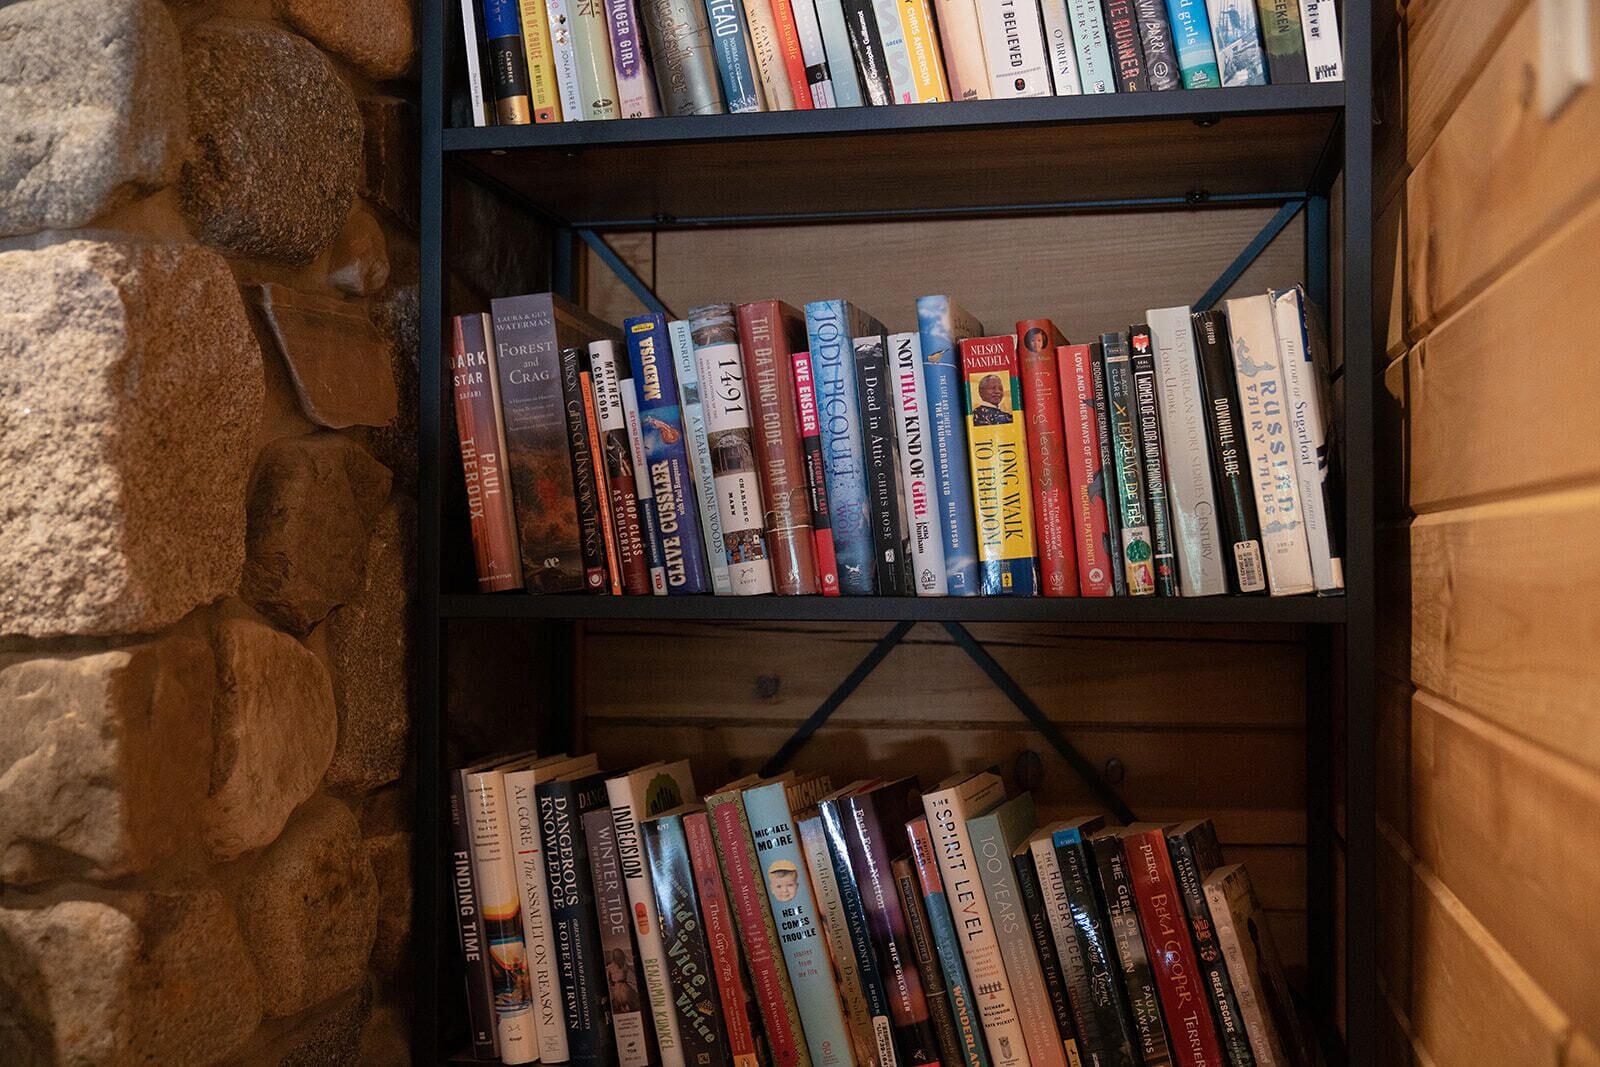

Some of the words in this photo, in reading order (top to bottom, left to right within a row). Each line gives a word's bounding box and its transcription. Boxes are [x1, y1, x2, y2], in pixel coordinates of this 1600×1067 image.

[526, 20, 538, 28] OF
[907, 7, 920, 35] CHRIS
[1090, 17, 1102, 48] TIME
[1145, 22, 1166, 54] BARRY
[1177, 11, 1199, 45] girls
[1307, 4, 1320, 38] River
[528, 32, 542, 60] CHOICE
[620, 41, 634, 69] GIRL
[729, 38, 738, 61] NORMA
[749, 9, 771, 84] WEIGHTMAN
[760, 26, 774, 62] GAVIN
[783, 24, 798, 60] Rushdie
[1003, 13, 1023, 67] BELIEVED
[1054, 29, 1069, 75] O'BRIEN
[913, 37, 930, 86] ANDERSON
[560, 50, 570, 78] JONAH
[566, 82, 577, 111] LEHRER
[496, 319, 551, 332] WATERMAN
[750, 317, 770, 343] THE
[814, 314, 842, 369] JODI
[1204, 321, 1216, 345] CLIFFORD
[498, 341, 554, 358] FOREST
[592, 353, 601, 364] B.
[677, 327, 691, 373] HEINRICH
[755, 347, 773, 366] DA
[897, 339, 913, 370] NOT
[965, 355, 1011, 369] MANDELA
[970, 343, 1004, 355] NELSON
[453, 371, 483, 387] STAR
[509, 369, 550, 385] CRAG
[604, 361, 620, 409] MATTHEW
[639, 336, 661, 400] MEDUSA
[715, 358, 744, 415] 1491
[795, 360, 810, 382] EVE
[1119, 368, 1129, 397] BLACK
[594, 366, 609, 420] CRAWFORD
[756, 368, 779, 407] VINCI
[865, 377, 881, 411] Dead
[900, 371, 918, 412] THAT
[1032, 371, 1052, 425] falling
[1138, 376, 1154, 405] WOMEN
[692, 416, 701, 425] A
[800, 386, 816, 431] ENSLER
[869, 416, 881, 430] in
[935, 402, 944, 418] THE
[1140, 405, 1155, 415] OF
[1214, 398, 1234, 447] DOWNHILL
[629, 411, 639, 436] BEYOND
[634, 436, 644, 467] MEASURE
[693, 427, 706, 456] YEAR
[762, 412, 783, 447] CODE
[823, 378, 855, 479] PICOULT
[905, 415, 922, 456] KIND
[1142, 416, 1157, 440] COLOR
[699, 457, 705, 465] in
[871, 434, 886, 467] Attic
[936, 420, 949, 479] THUNDERBOLT
[974, 438, 995, 460] TO
[997, 442, 1019, 486] LONG
[1039, 431, 1055, 487] leaves
[1146, 441, 1160, 459] AND
[1222, 449, 1240, 477] SLIDE
[1247, 383, 1265, 444] FAIRY
[1257, 454, 1276, 515] TALES
[460, 437, 483, 520] THEROUX
[480, 453, 501, 499] PAUL
[768, 458, 788, 486] DAN
[910, 458, 926, 479] OF
[1147, 459, 1163, 495] FEMINISM
[612, 489, 623, 502] AS
[624, 493, 637, 519] SHOP
[651, 459, 679, 534] CUSSLER
[702, 475, 717, 512] MAINE
[728, 492, 736, 516] MANN
[877, 472, 889, 507] CHRIS
[911, 481, 928, 519] GIRL
[943, 481, 951, 496] KID
[975, 467, 1002, 546] FREEDOM
[1080, 485, 1091, 522] MICHAEL
[772, 492, 795, 541] BROWN
[881, 511, 892, 540] ROSE
[948, 502, 957, 519] BILL
[1003, 492, 1024, 540] WALK
[615, 505, 631, 564] SOULCRAFT
[630, 524, 643, 557] CLASS
[709, 512, 724, 554] WOODS
[916, 522, 925, 554] Dunham
[951, 520, 960, 548] BRYSON
[1084, 523, 1095, 566] PATERNITI
[662, 535, 686, 587] CLIVE
[654, 572, 663, 590] TED
[515, 785, 528, 804] AL
[517, 807, 533, 846] GORE
[612, 805, 643, 880] INDECISION
[524, 859, 536, 880] The
[540, 796, 565, 910] KNOWLEDGE
[555, 796, 579, 906] DANGEROUS
[598, 826, 619, 892] WINTER
[981, 836, 1002, 873] 100
[1044, 852, 1055, 868] THE
[453, 852, 475, 916] FINDING
[936, 808, 967, 870] SPIRIT
[954, 879, 983, 941] LEVEL
[1067, 850, 1084, 894] PORTER
[1176, 860, 1192, 895] LONDON
[526, 883, 543, 944] ASSAULT
[991, 877, 1019, 935] YEARS
[1049, 872, 1075, 930] HUNGRY
[1110, 855, 1123, 881] THE
[1117, 884, 1131, 915] GIRL
[1126, 918, 1138, 936] ON
[607, 894, 625, 935] TIDE
[462, 922, 480, 962] TIME
[677, 929, 689, 943] to
[1032, 912, 1050, 961] NUMBER
[1110, 900, 1123, 929] THE
[1118, 933, 1136, 974] TRAIN
[535, 945, 547, 965] ON
[667, 939, 706, 987] Vice
[1065, 935, 1086, 983] OCEAN
[1140, 843, 1160, 884] PIERCE
[1151, 893, 1175, 936] BEKA
[1164, 940, 1192, 1009] COOPER
[1184, 1010, 1207, 1067] TERRIER
[558, 921, 573, 980] ROBERT
[566, 985, 579, 1030] IRWIN
[646, 958, 665, 1007] BENJAMIN
[683, 982, 702, 1000] and
[888, 942, 900, 962] ERIC
[894, 964, 912, 1012] SCHLOSSER
[1046, 966, 1058, 986] THE
[537, 970, 555, 1026] REASON
[1051, 992, 1069, 1027] STARS
[1142, 985, 1158, 1024] PAULA
[1210, 970, 1226, 998] GREAT
[1219, 999, 1235, 1033] ESCAPE
[655, 1011, 675, 1051] KUNKEL
[675, 991, 716, 1044] Virtue
[1134, 1000, 1155, 1054] HAWKINS
